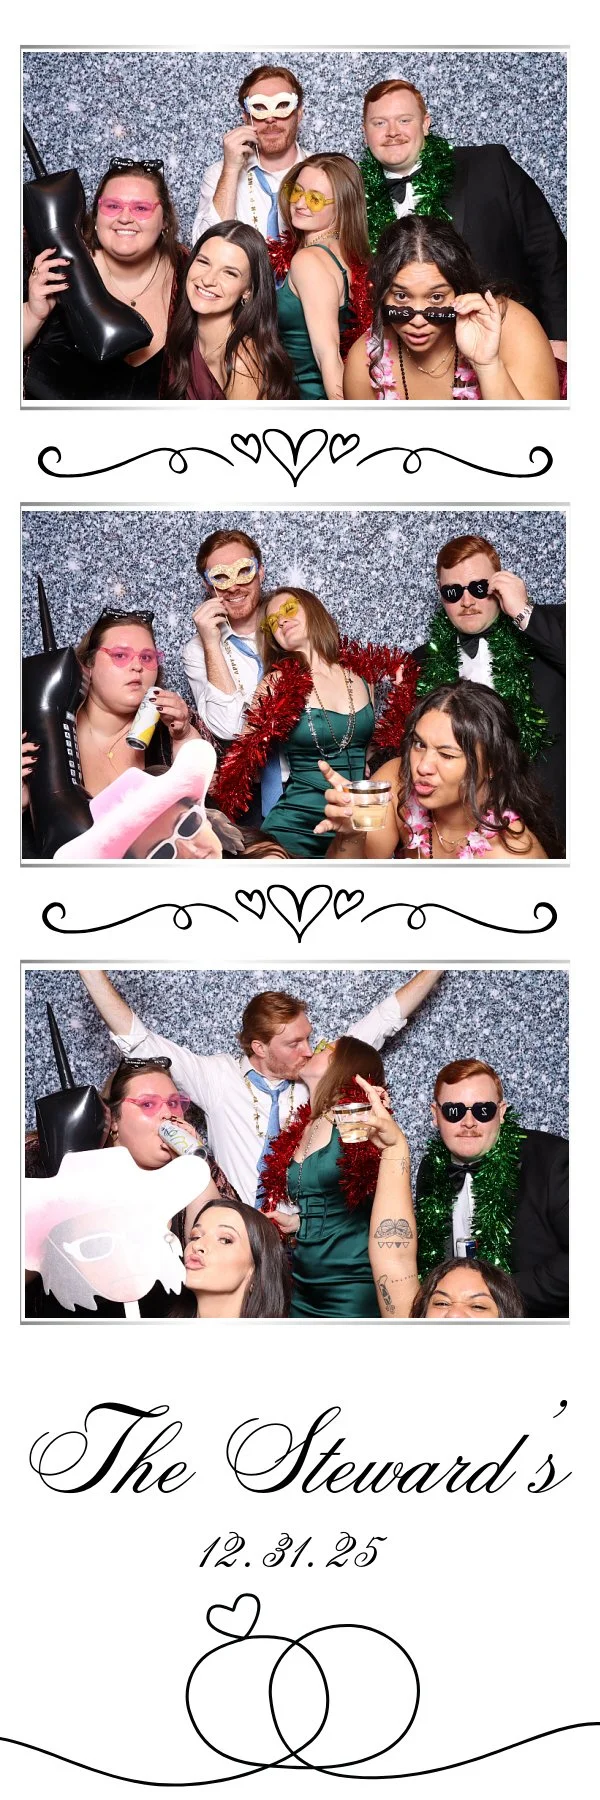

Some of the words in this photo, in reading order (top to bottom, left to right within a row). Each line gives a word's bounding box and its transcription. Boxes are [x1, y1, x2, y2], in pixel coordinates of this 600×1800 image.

[446, 588, 457, 598] M
[476, 584, 484, 593] S
[448, 1107, 458, 1117] M
